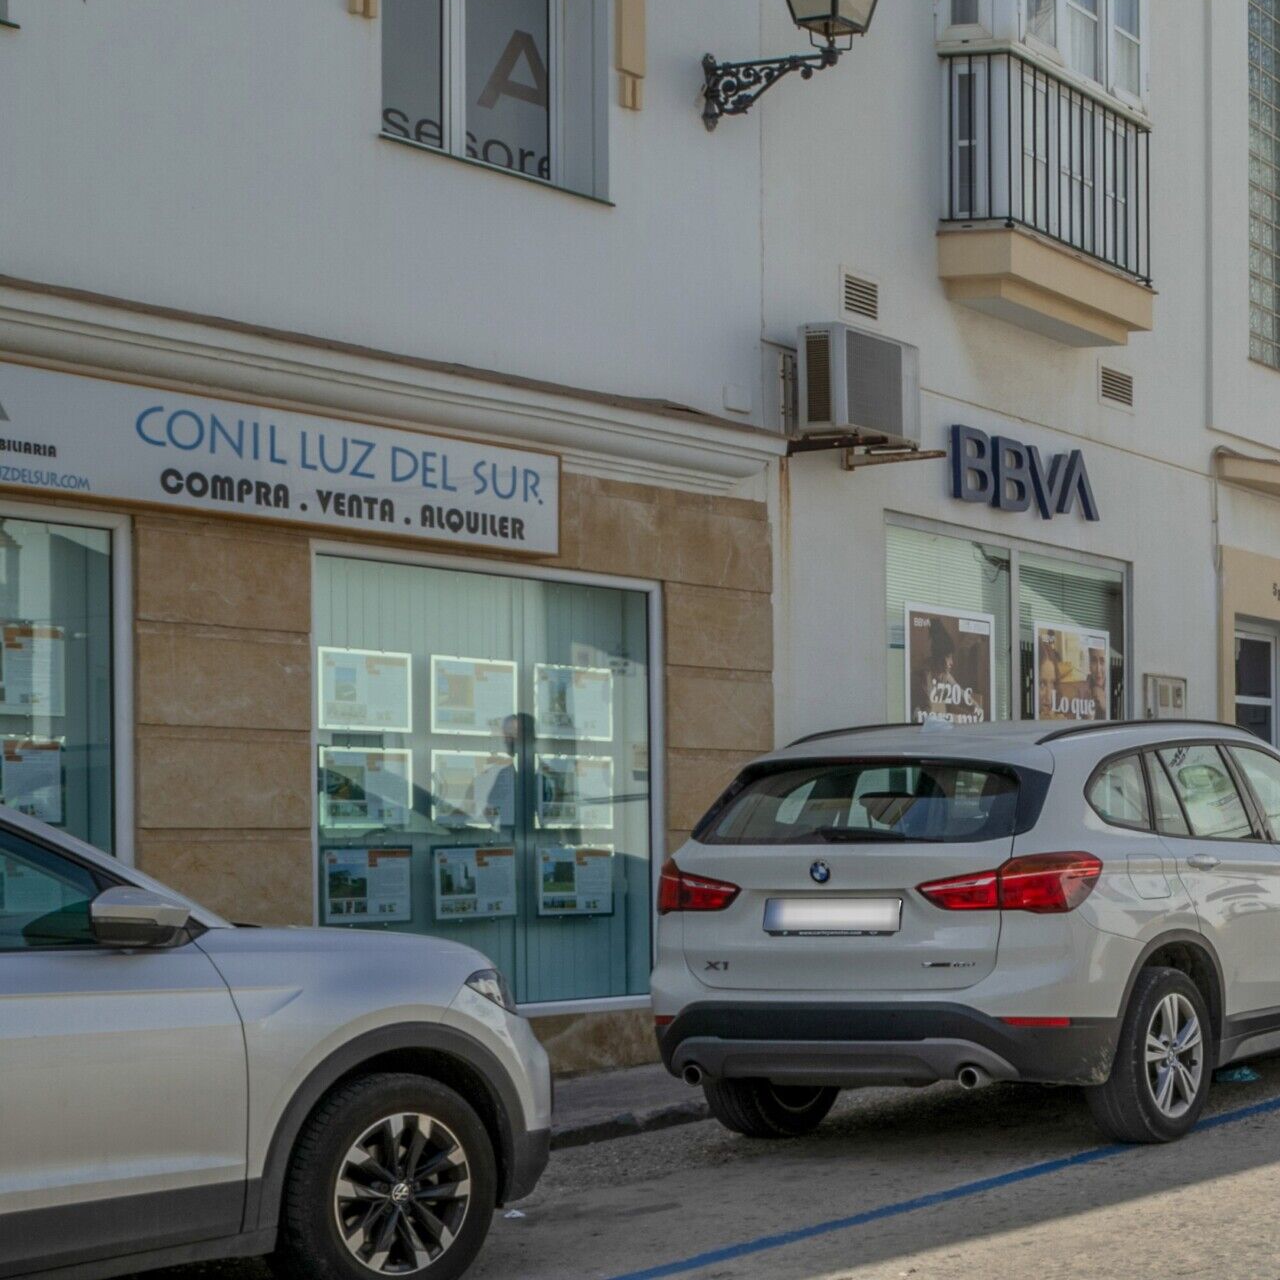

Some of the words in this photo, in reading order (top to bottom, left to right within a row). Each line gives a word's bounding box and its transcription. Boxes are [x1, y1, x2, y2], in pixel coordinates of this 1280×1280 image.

[477, 29, 548, 110] A
[0, 465, 90, 491] ZDELSUR.COM
[136, 406, 287, 465] CONIL
[300, 430, 376, 479] LUZ
[391, 445, 457, 492] DEL
[951, 424, 1100, 522] BBVA
[160, 468, 290, 509] COMPRA
[315, 489, 395, 524] VENTA
[420, 504, 525, 541] ALQUILER
[929, 678, 961, 705] ¿720
[963, 687, 974, 707] €
[1051, 689, 1069, 714] Lo
[1071, 697, 1096, 720] que
